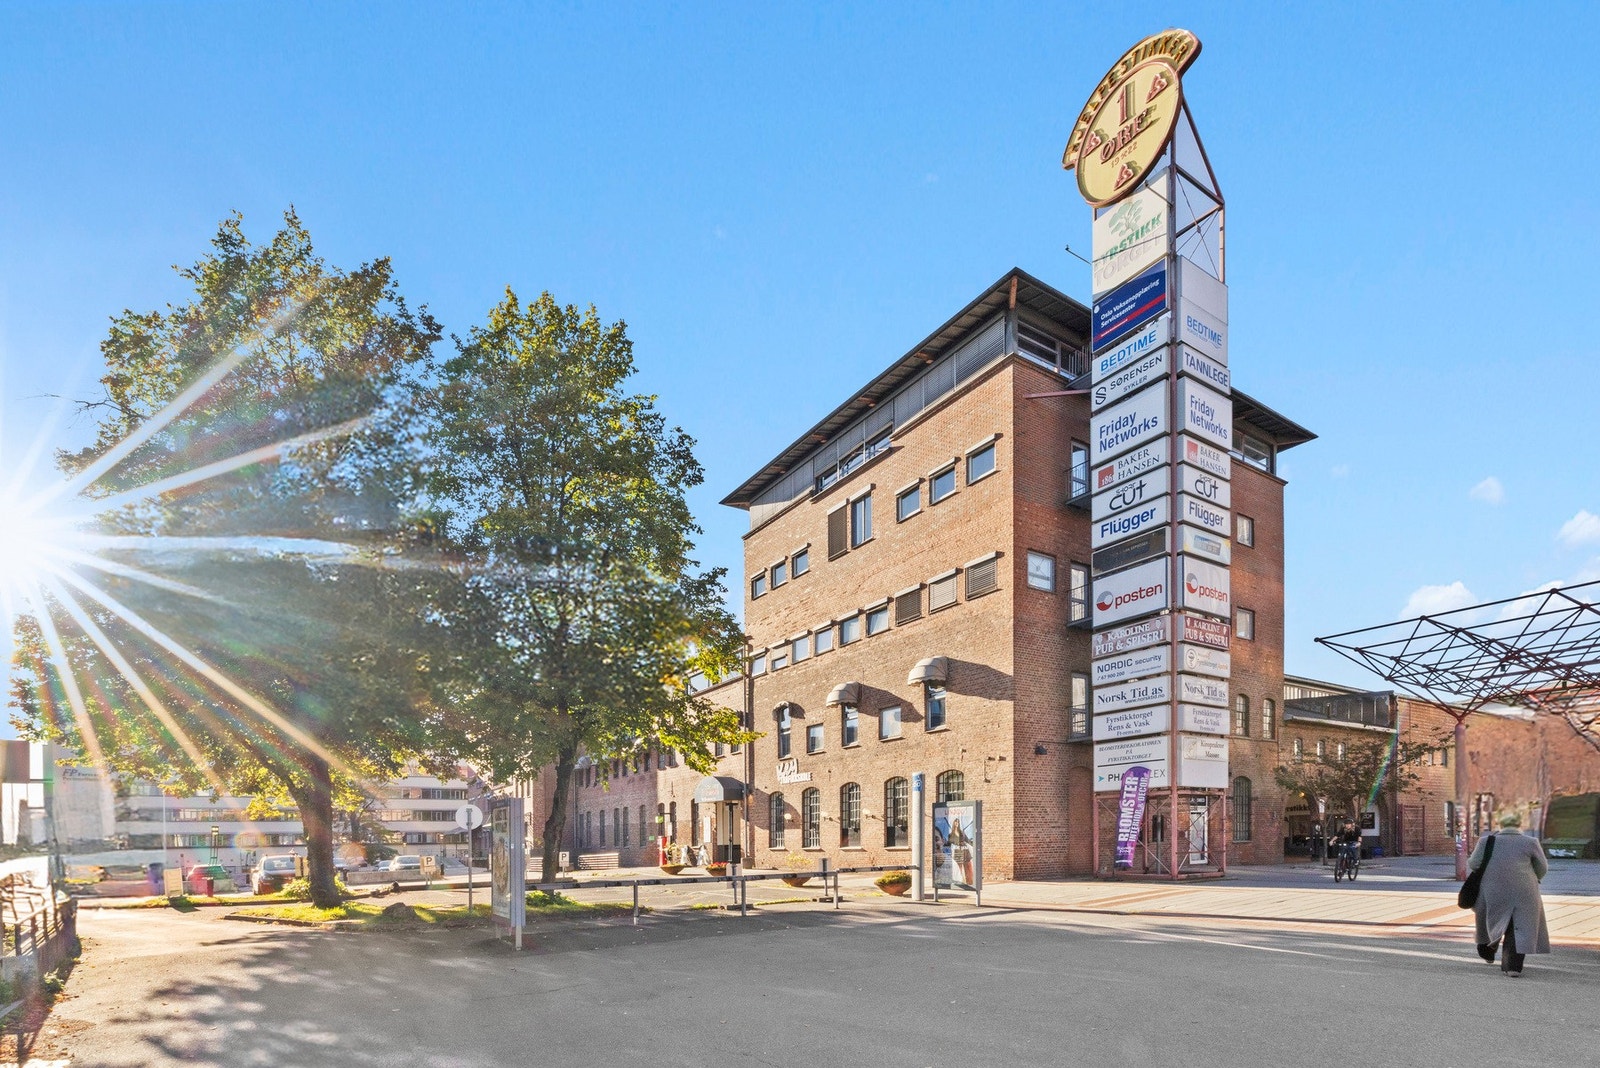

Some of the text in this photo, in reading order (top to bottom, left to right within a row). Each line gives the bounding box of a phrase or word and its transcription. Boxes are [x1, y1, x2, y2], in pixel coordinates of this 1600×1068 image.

[1117, 83, 1133, 126] 1
[1101, 302, 1136, 328] Servicesenter
[1101, 310, 1113, 321] Oslo
[1187, 315, 1223, 346] BEDTIME
[1100, 330, 1157, 372] BEDTIME
[1110, 354, 1163, 390] SØRENSEN
[1185, 352, 1228, 387] TANNLEGE
[1123, 375, 1147, 393] SYKLER
[1190, 395, 1215, 421] Friday
[1099, 411, 1137, 439] Friday
[1099, 416, 1158, 453] Networks
[1190, 410, 1228, 440] Networks
[1117, 448, 1150, 469] BAKER
[1200, 446, 1221, 463] BAKER
[1200, 459, 1227, 475] HANSEN
[1117, 455, 1160, 480] HANSEN
[1100, 508, 1157, 538] Flügger
[1188, 501, 1224, 526] Flügger
[1115, 584, 1163, 609] posten
[1199, 584, 1228, 602] posten
[1107, 623, 1150, 639] KAROLINE
[1185, 628, 1228, 647] PUB & SPISERI
[1193, 620, 1220, 634] KAROLINE
[1095, 630, 1165, 656] PUB & SPISERI
[1097, 658, 1133, 673] NORDIC
[1135, 655, 1162, 666] security
[1098, 686, 1163, 704] Norsk Tid as
[1184, 682, 1226, 698] Norsk Tid as
[1106, 710, 1153, 724] Fyrstikktorget
[1107, 723, 1124, 731] Rens
[1133, 719, 1150, 728] Vask
[1118, 776, 1139, 842] BLOMSTER
[426, 856, 432, 864] P
